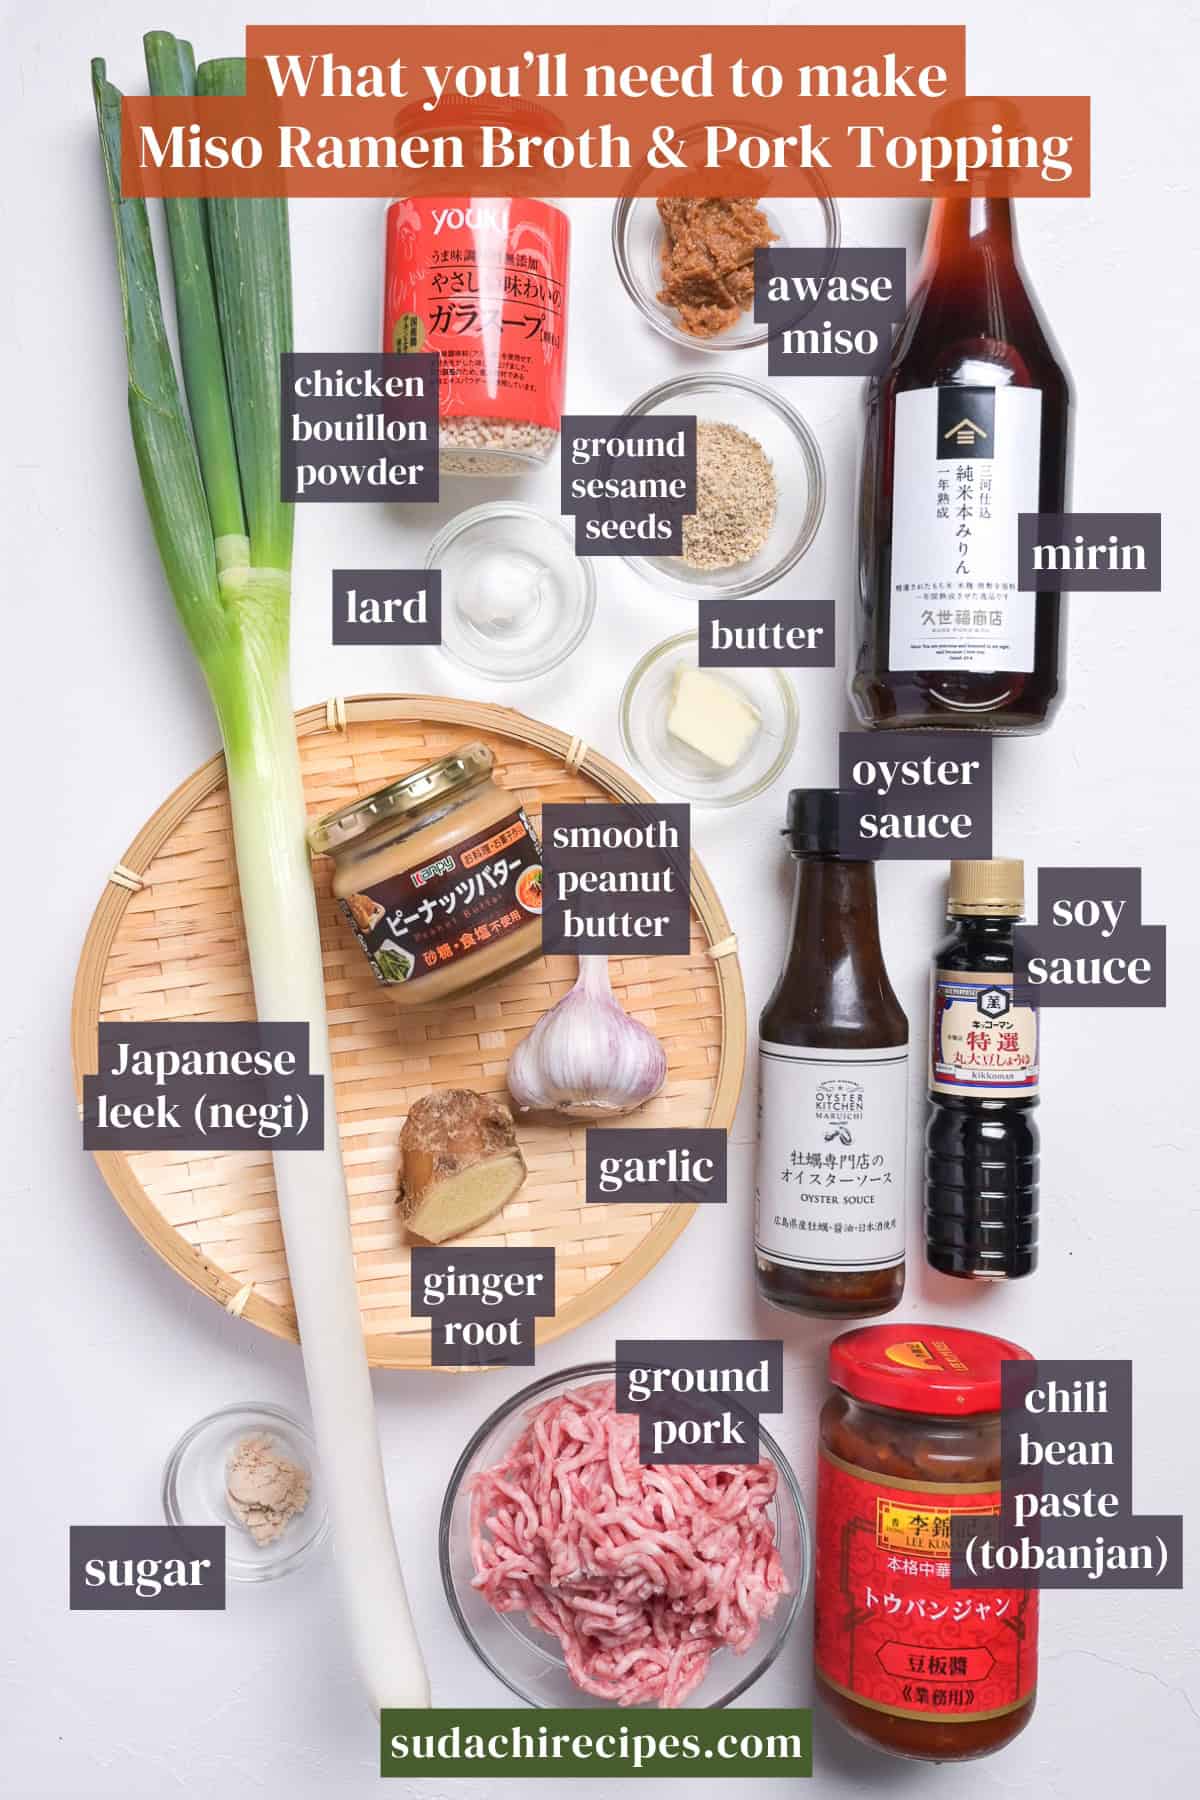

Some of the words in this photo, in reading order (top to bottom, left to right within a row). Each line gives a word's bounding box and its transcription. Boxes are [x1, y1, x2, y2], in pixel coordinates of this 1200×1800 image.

[431, 271, 562, 308] やさし味わいの
[955, 464, 974, 575] 純米本みりん
[386, 858, 522, 937] ピーナッツバター
[815, 1092, 864, 1102] OYSTER
[815, 1101, 864, 1111] KITCHEN
[780, 1167, 894, 1188] オイスターソース
[800, 1193, 839, 1206] OYSTER
